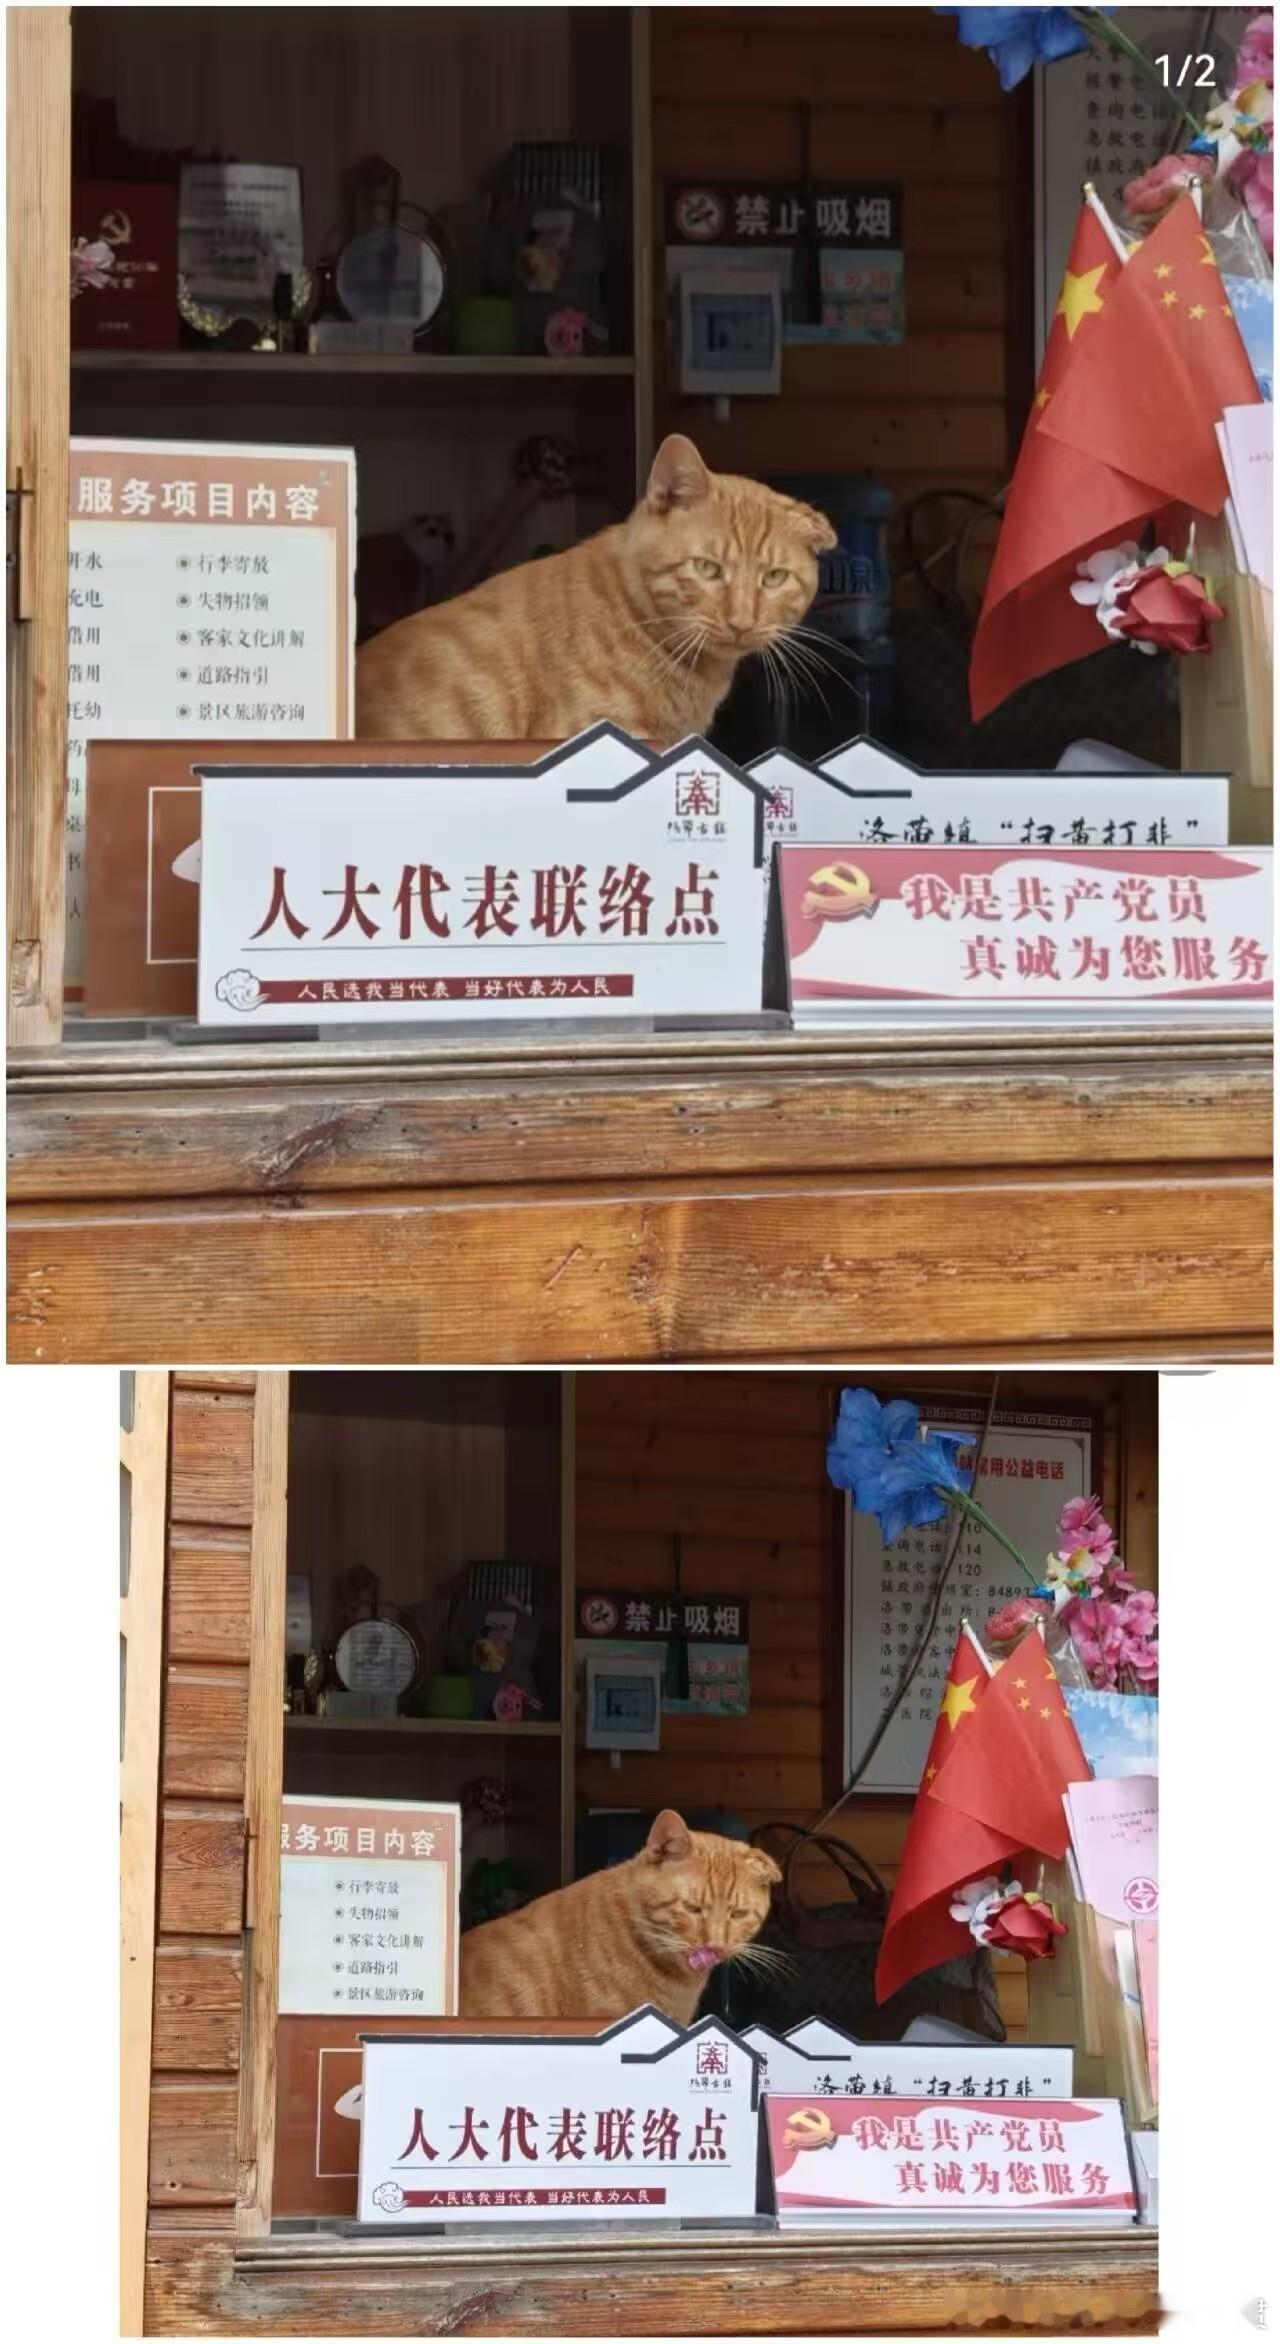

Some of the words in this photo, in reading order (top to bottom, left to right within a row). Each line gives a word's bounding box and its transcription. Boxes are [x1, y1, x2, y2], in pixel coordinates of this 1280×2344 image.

[735, 193, 891, 238] 禁止吸烟
[77, 476, 320, 521] 服务项目内容
[198, 554, 270, 575] 行李寄放
[197, 592, 270, 612] 失物招领
[197, 628, 305, 649] 客家文化讲解
[197, 665, 269, 685] 道路指引
[198, 702, 305, 723] 景区旅游咨询
[249, 860, 721, 941] 人大代表联络点
[902, 875, 1208, 923] 我是共产党员
[962, 934, 1273, 983] 真诚为您服务
[298, 979, 451, 1001] 人民选我当代表
[463, 975, 611, 998] 当好代表为人民
[957, 1564, 982, 1577] 120
[625, 1602, 739, 1636] 禁止吸烟
[349, 1880, 399, 1894] 行李寄放
[349, 1907, 399, 1920] 失物招领
[348, 1933, 423, 1948] 客家文化讲解
[348, 1961, 398, 1975] 道路指引
[348, 1987, 423, 2001] 景区旅游咨询
[397, 2106, 728, 2162] 人大代表联络点
[853, 2116, 1066, 2153] 我是共产党员
[895, 2161, 1110, 2195] 真诚为您服务
[429, 2191, 537, 2206] 人民选我当代表
[547, 2188, 651, 2205] 当好代表为人民
